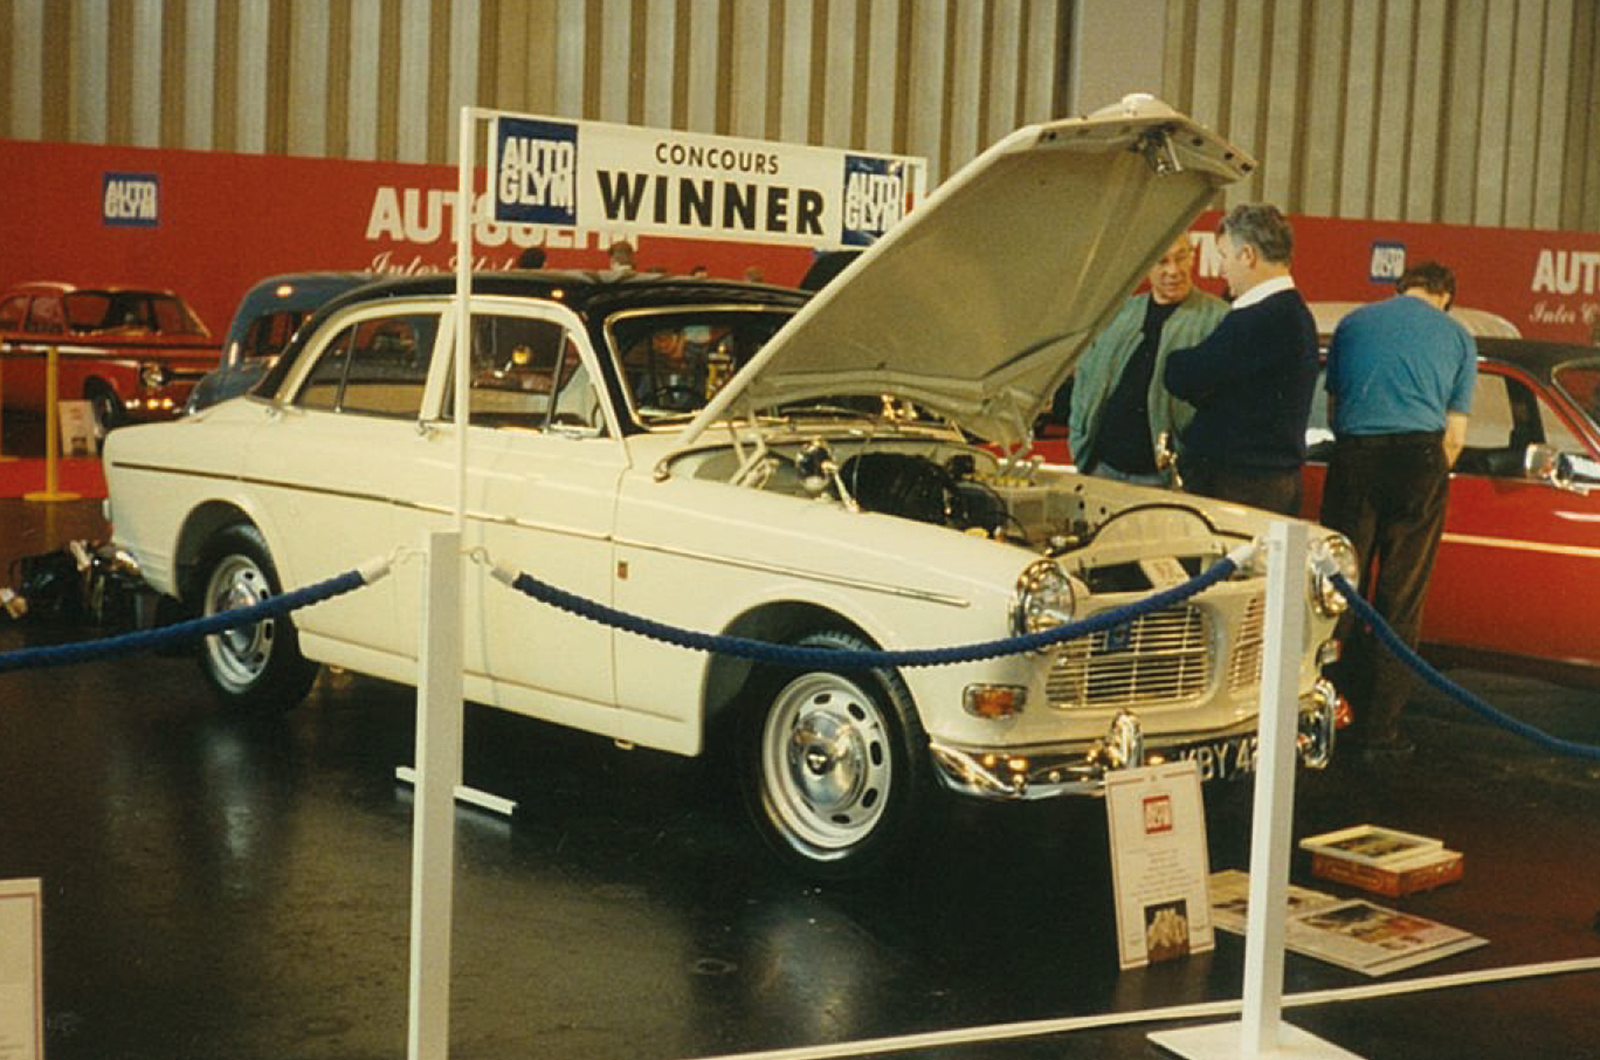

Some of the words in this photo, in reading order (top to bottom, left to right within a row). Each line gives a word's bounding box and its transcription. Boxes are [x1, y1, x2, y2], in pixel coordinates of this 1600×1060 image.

[501, 136, 575, 174] AUTO
[655, 142, 780, 175] CONCOURS
[105, 180, 156, 201] AUTO
[499, 170, 575, 208] GLYM
[596, 169, 825, 236] WINNER
[848, 171, 901, 206] AUTO
[1531, 248, 1600, 295] AUT
